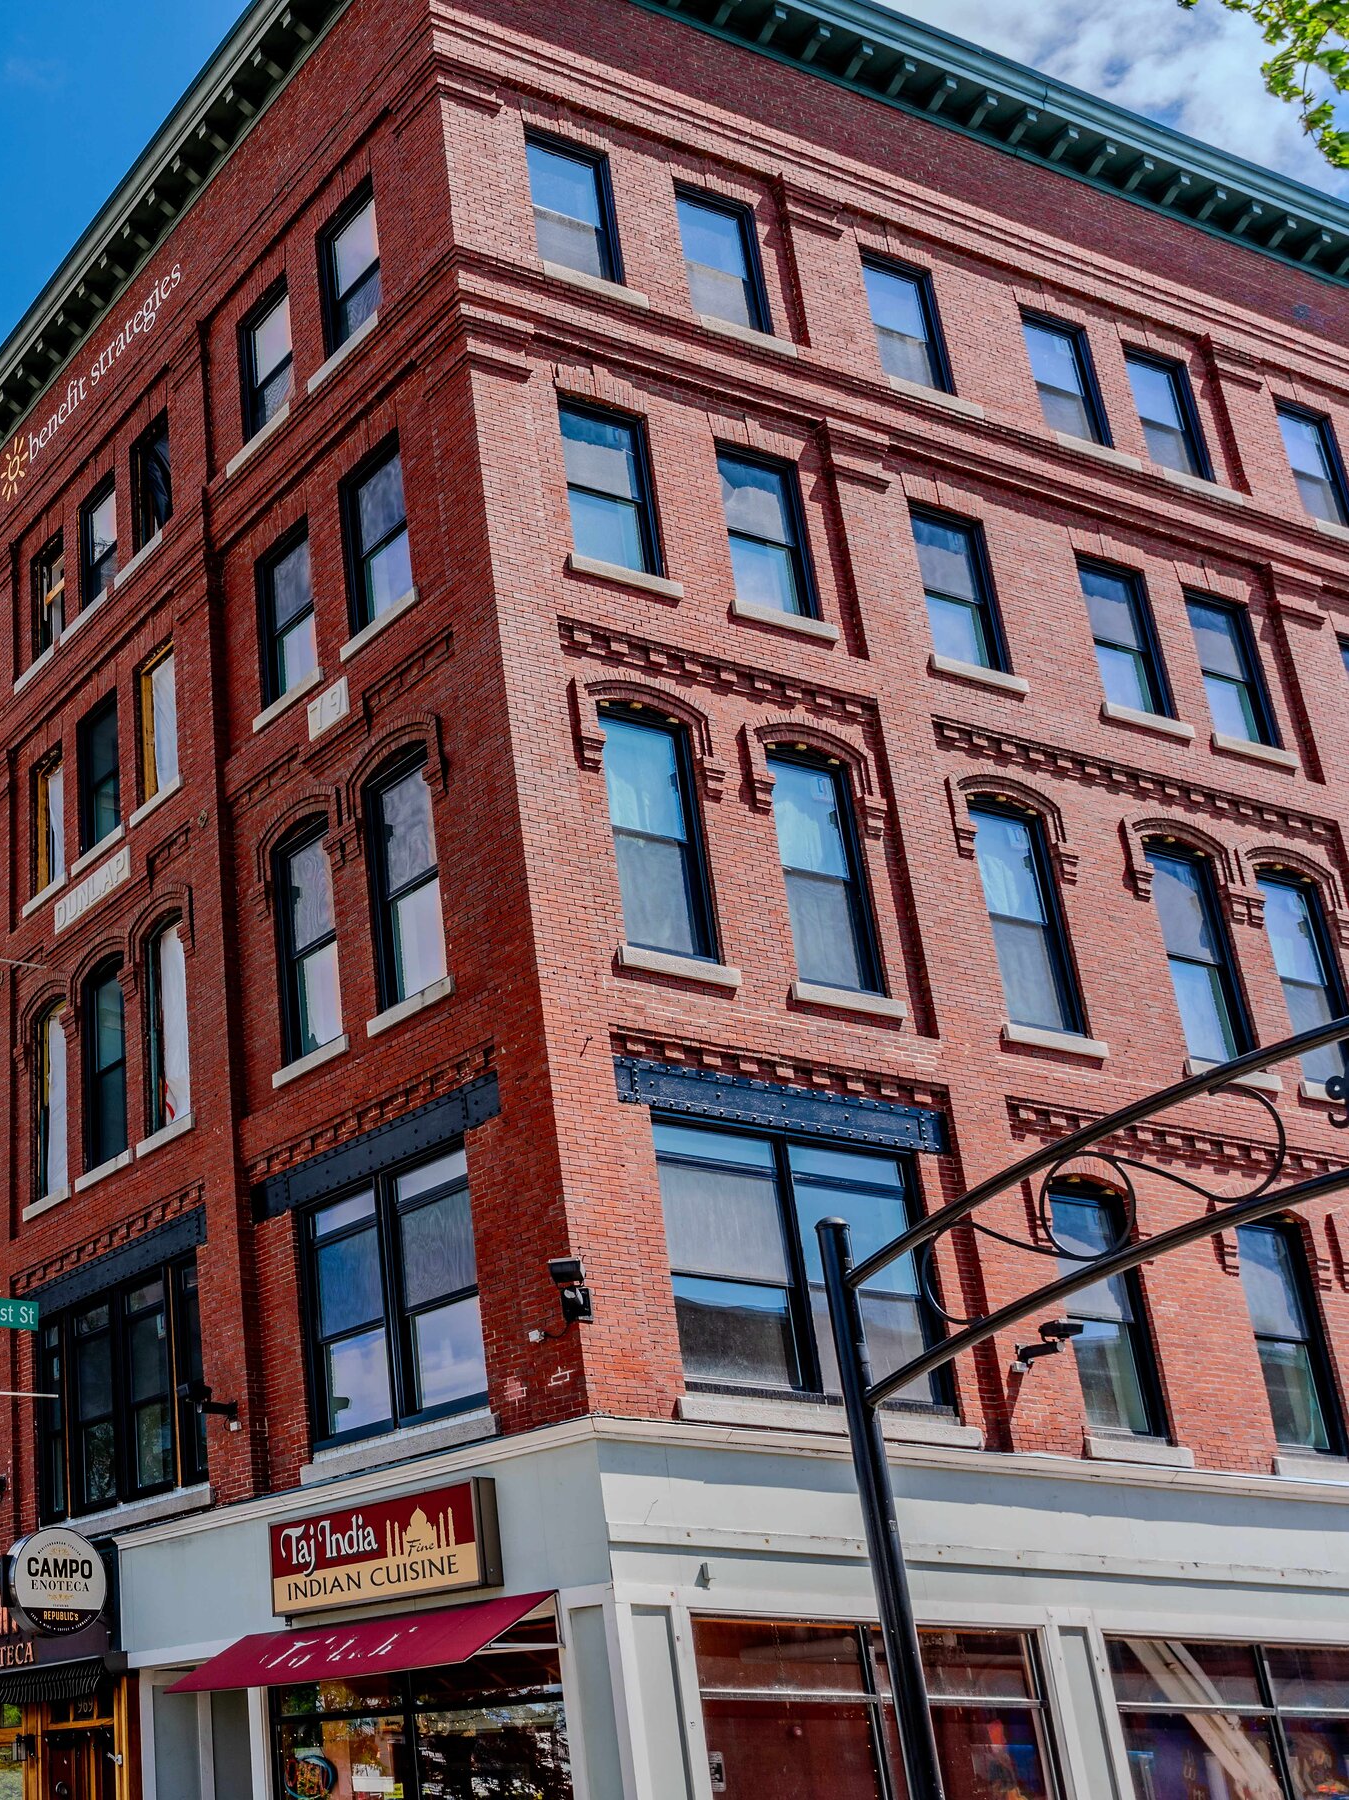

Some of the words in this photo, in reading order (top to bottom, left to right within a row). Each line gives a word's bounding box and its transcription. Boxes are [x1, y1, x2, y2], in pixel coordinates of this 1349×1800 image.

[28, 380, 87, 463] benefit
[90, 263, 181, 386] strategies
[309, 686, 342, 730] 79
[56, 852, 126, 931] DUNLAP
[19, 1306, 35, 1324] St
[280, 1524, 317, 1577] Taj
[317, 1513, 379, 1560] India
[406, 1538, 436, 1557] Fine
[27, 1556, 93, 1580] CAMPO
[31, 1579, 90, 1593] ENOTECA
[287, 1570, 362, 1602] INDIAN
[370, 1553, 460, 1587] CUISINE
